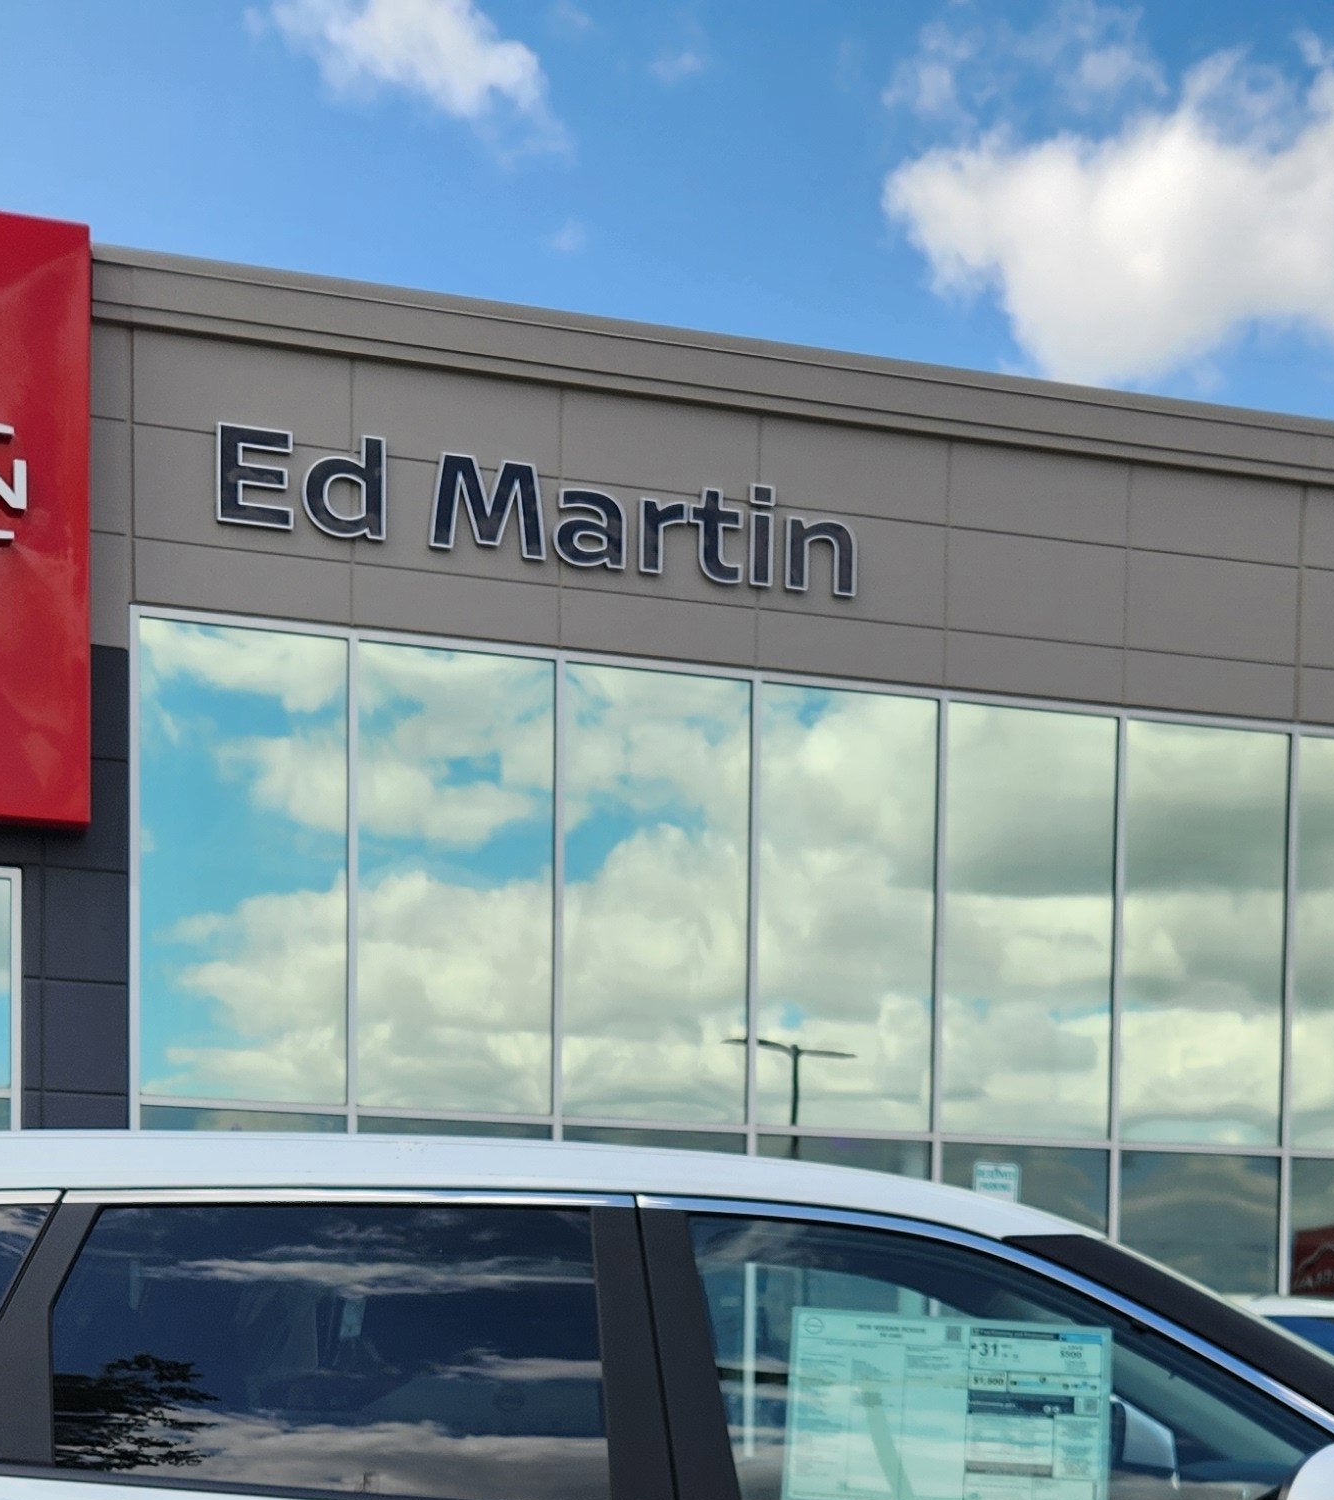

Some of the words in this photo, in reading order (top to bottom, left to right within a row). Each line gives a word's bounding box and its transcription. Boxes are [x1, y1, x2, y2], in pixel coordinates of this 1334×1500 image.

[215, 421, 387, 541] Ed
[428, 451, 857, 598] Martin
[978, 1342, 999, 1358] 31
